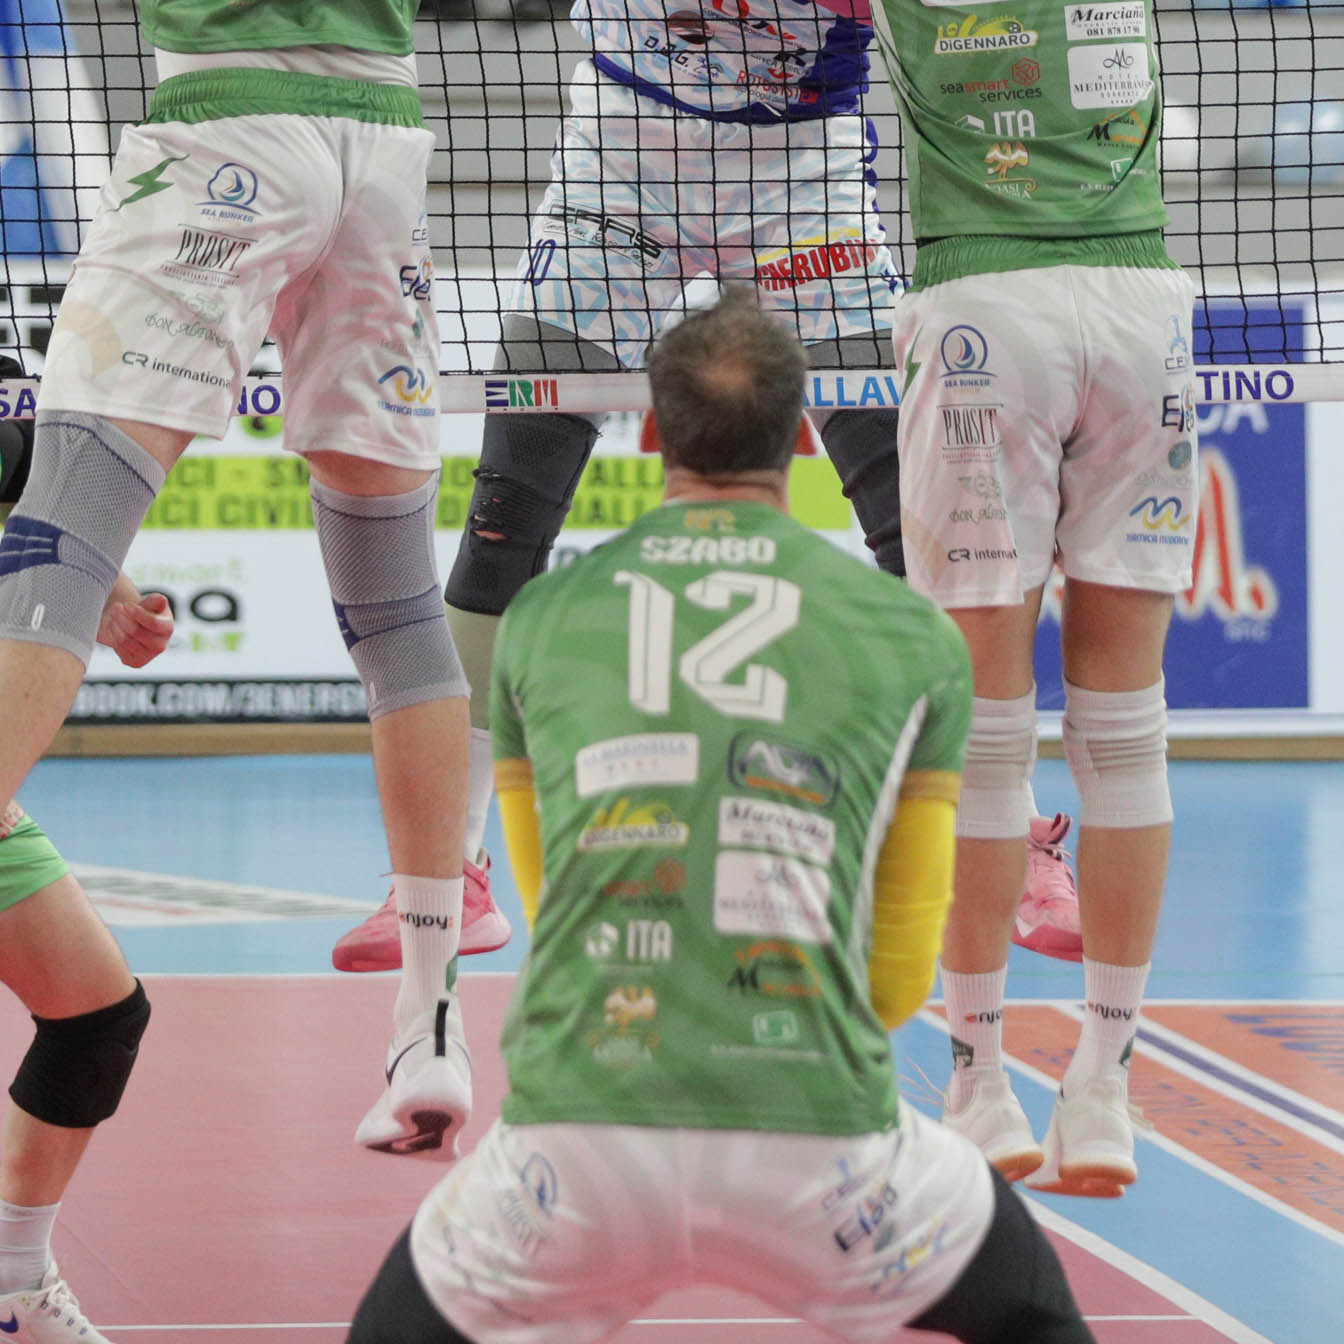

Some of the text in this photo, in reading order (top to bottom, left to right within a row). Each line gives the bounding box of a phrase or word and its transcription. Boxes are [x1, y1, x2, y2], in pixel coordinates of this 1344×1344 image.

[979, 85, 1042, 103] services
[993, 109, 1036, 138] ITA
[175, 228, 251, 272] PROSIT
[942, 408, 999, 446] PROSIT
[639, 534, 777, 566] SZABO
[613, 570, 802, 725] 12
[626, 920, 673, 961] ITA
